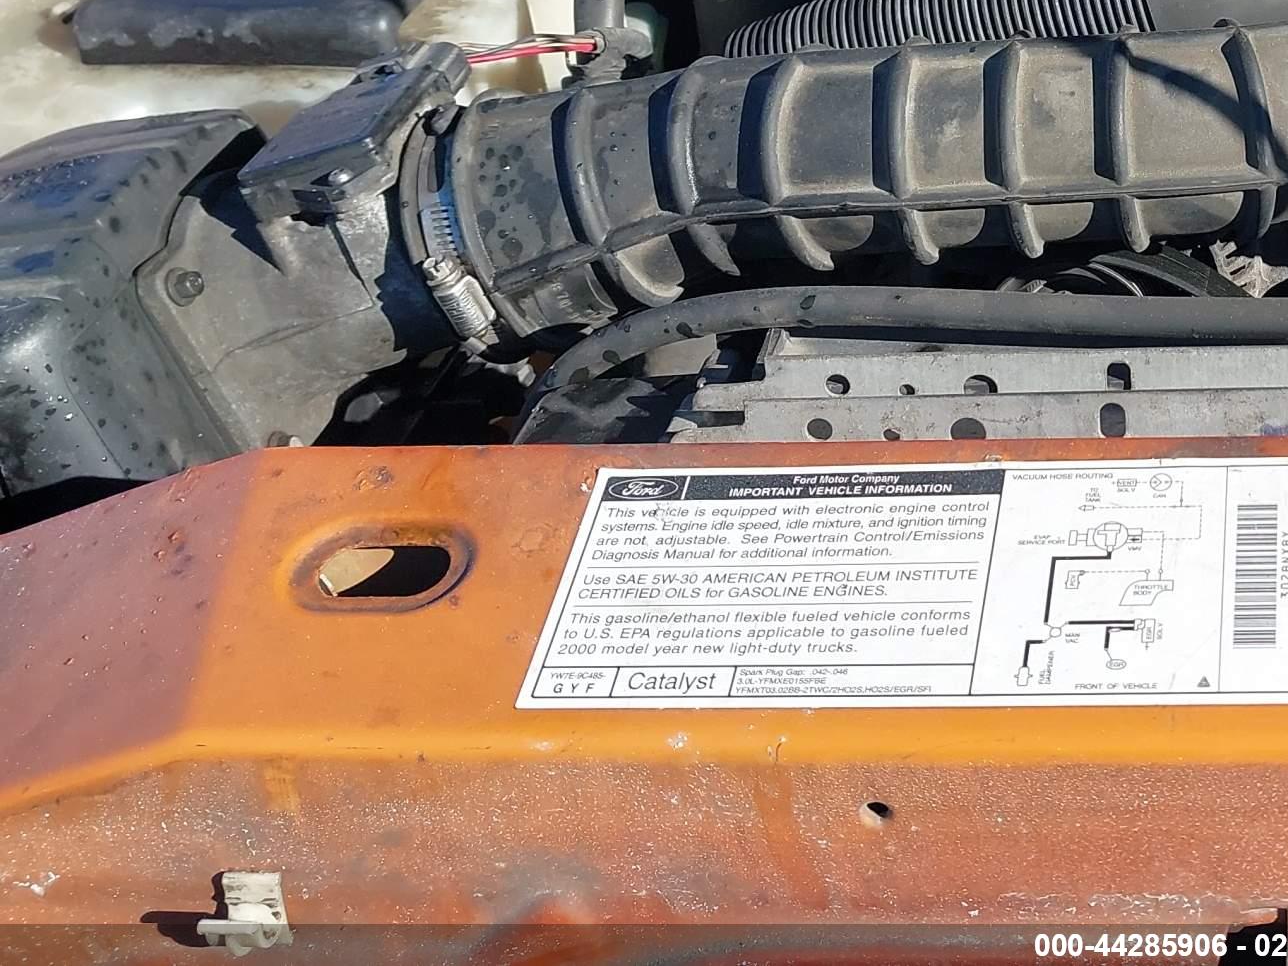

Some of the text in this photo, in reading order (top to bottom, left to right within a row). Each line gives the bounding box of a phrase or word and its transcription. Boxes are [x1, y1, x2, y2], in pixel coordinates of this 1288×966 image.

[793, 474, 900, 485] Ford Motor Company
[1076, 472, 1113, 480] ROUTING
[621, 481, 665, 497] Ford
[728, 484, 953, 498] IMPORTANT VEHICLE INFORMATION
[607, 507, 636, 518] This
[694, 506, 707, 517] is
[711, 505, 778, 519] equipped
[782, 505, 810, 520] with
[815, 503, 884, 519] electronic
[888, 502, 937, 518] engine
[941, 500, 990, 517] control
[601, 514, 988, 534] systems. Engine idle speed, idle mixture, and ignition timing
[595, 532, 620, 547] are
[655, 531, 731, 548] adjustable.
[740, 530, 769, 545] See
[773, 532, 849, 544] Powertrain
[853, 528, 985, 543] Control/Emissions
[591, 545, 893, 563] Diagnosis Manual for additional information.
[583, 568, 979, 586] Use SAE 5W-30 AMERICAN PETROLEUM INSTITUTE
[578, 583, 888, 600] CERTIFIED OILS for GASOLINE ENGINES.
[570, 608, 971, 628] This gasoline/ethanol flexible fueled vehicle conforms
[563, 624, 969, 642] to U.S. EPA regulations applicable to gasoline fueled
[556, 639, 858, 658] 2000 model year new light-duty trucks.
[740, 669, 764, 677] Spark
[766, 668, 783, 677] Plug
[552, 682, 596, 694] G Y F
[627, 671, 717, 694] Catalyst
